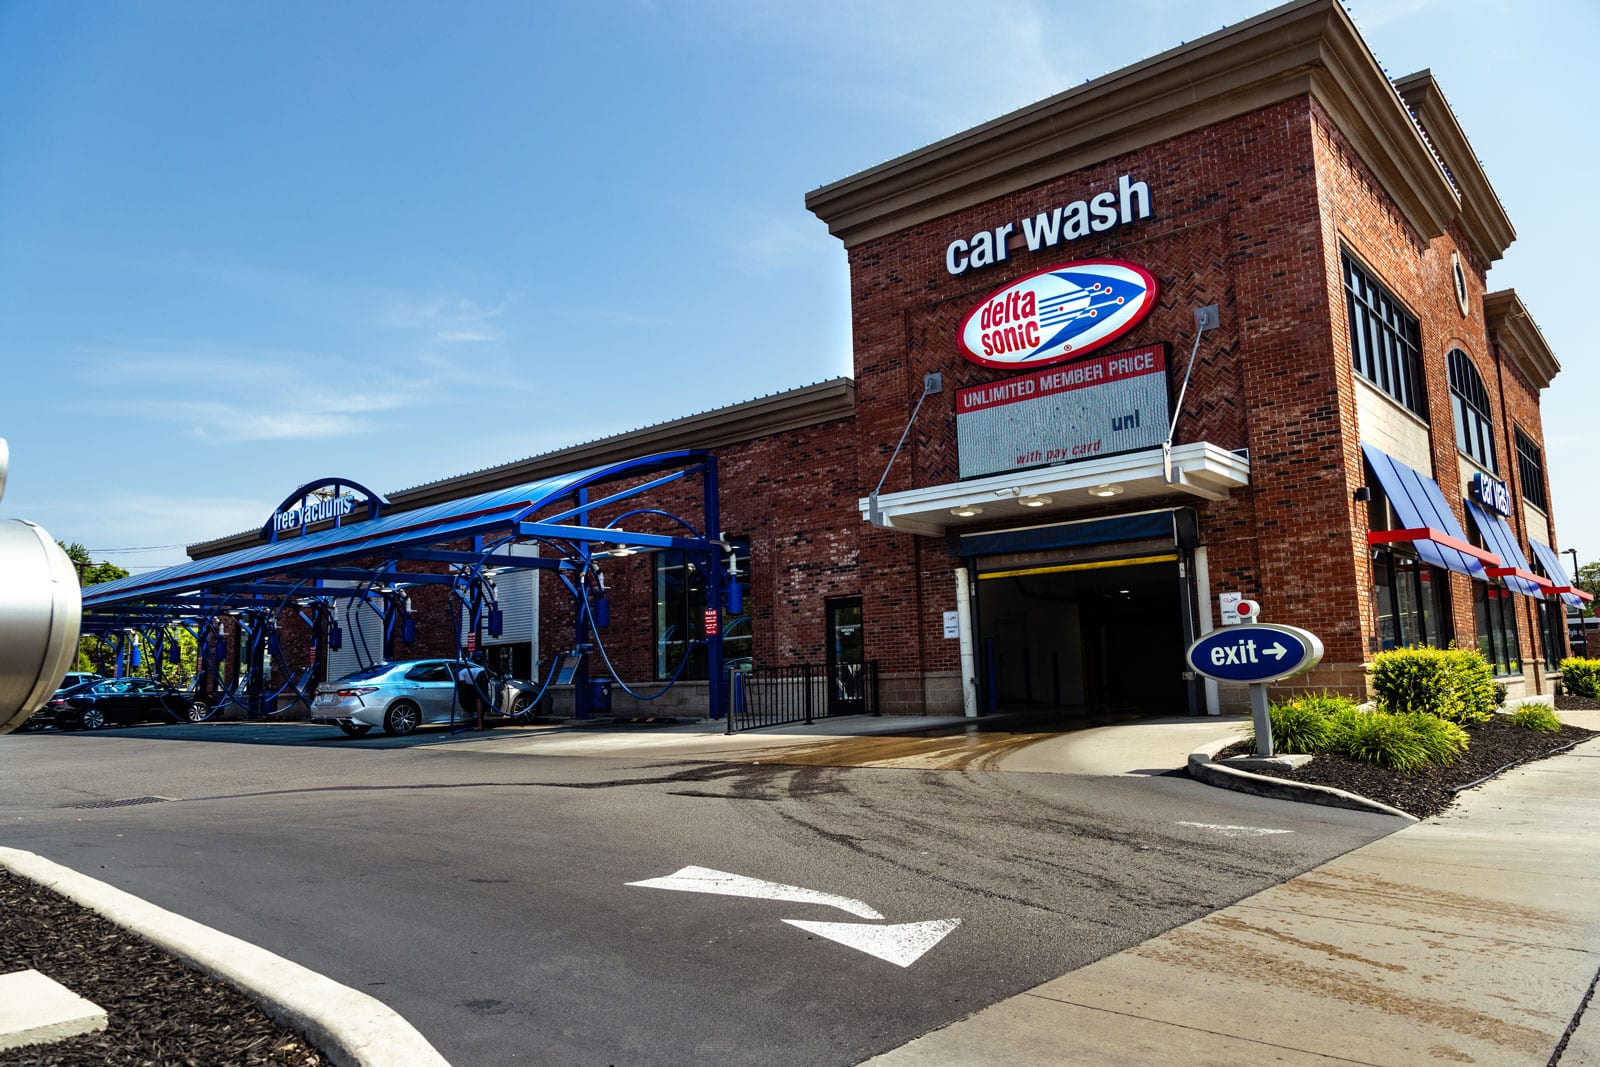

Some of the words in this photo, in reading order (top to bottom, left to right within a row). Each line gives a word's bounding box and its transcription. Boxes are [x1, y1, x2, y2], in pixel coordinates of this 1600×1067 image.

[946, 222, 1013, 275] car
[1021, 174, 1150, 252] wash
[981, 290, 1036, 331] delta
[981, 321, 1040, 357] sonic
[963, 380, 1035, 408] UNLIMITED
[1039, 365, 1103, 391] MEMBER
[1108, 352, 1154, 376] PRICE
[1016, 451, 1042, 465] with
[1047, 446, 1069, 463] pay
[1072, 439, 1101, 456] card
[298, 496, 352, 525] vacuums
[1210, 639, 1259, 666] exit
